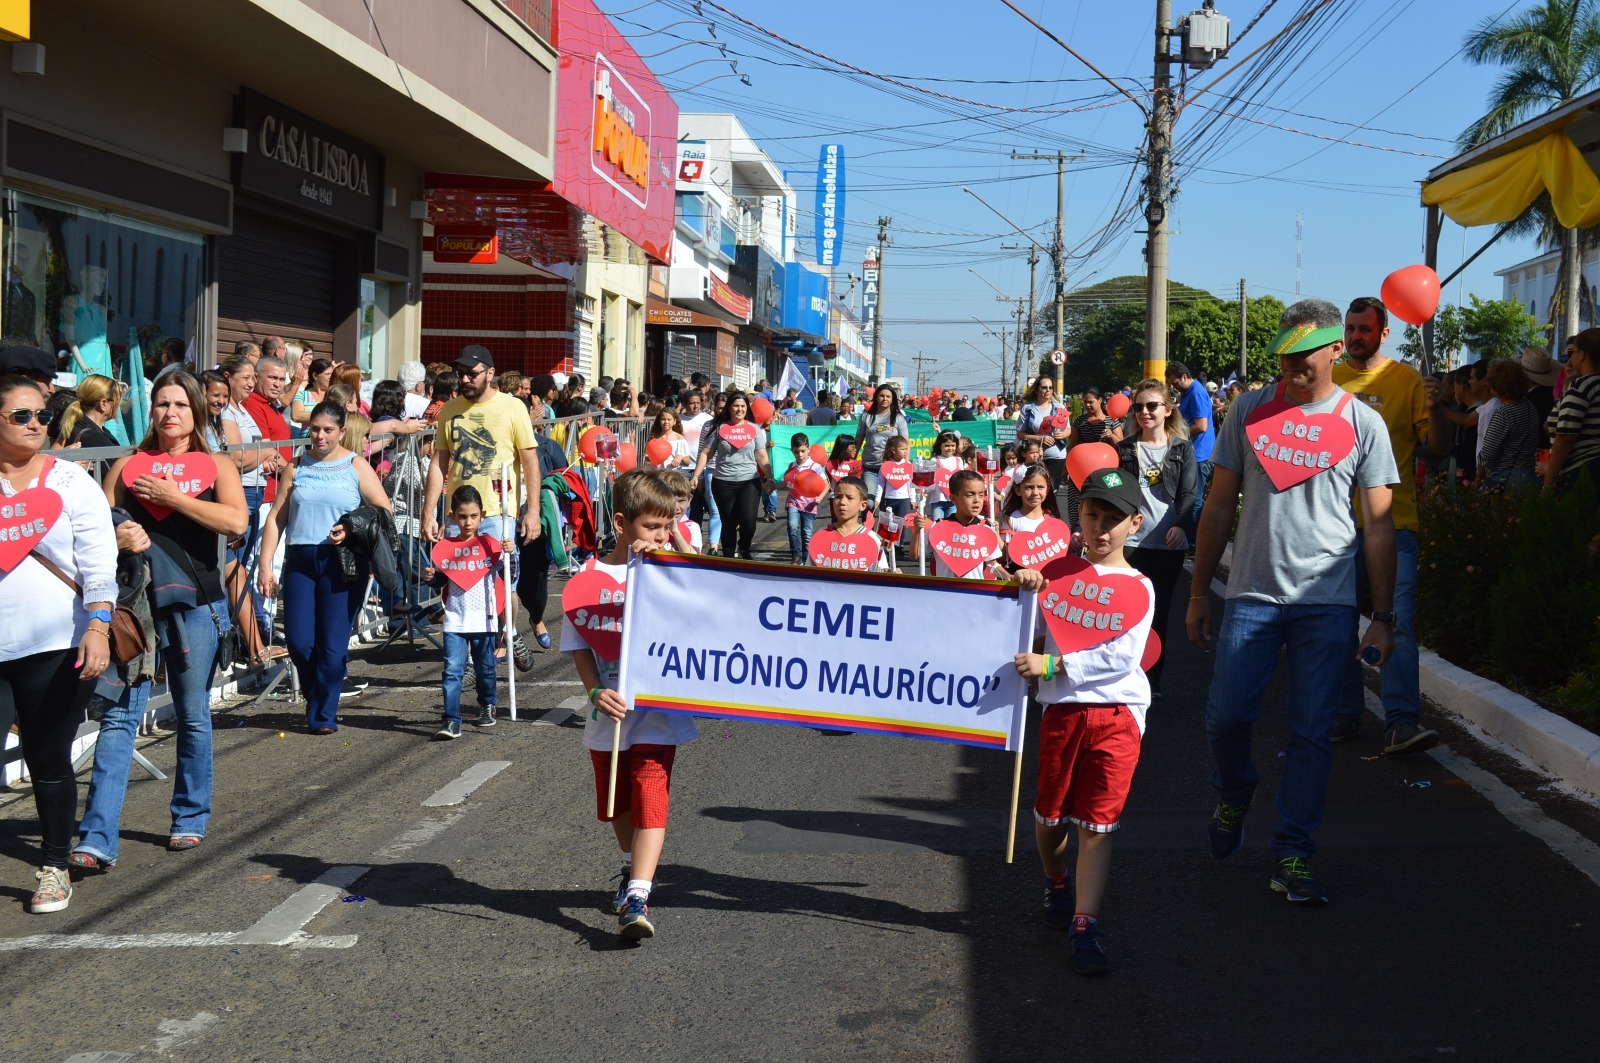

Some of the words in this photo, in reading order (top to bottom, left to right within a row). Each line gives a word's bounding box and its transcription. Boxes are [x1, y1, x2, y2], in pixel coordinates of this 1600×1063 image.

[259, 114, 310, 173] CASA
[311, 136, 370, 197] LISBOA
[682, 150, 706, 160] Raia
[300, 179, 319, 201] desde
[822, 144, 838, 265] magazineluiza
[441, 241, 490, 251] POPULAR
[669, 316, 692, 324] CACAU
[1281, 420, 1322, 442] DOE
[1253, 434, 1331, 469] SANGUE
[0, 502, 27, 520] OE
[0, 517, 48, 543] NGUE
[952, 532, 977, 546] DOE
[829, 541, 856, 555] DOE
[936, 540, 989, 560] SANGUE
[1026, 532, 1052, 550] DOE
[454, 545, 480, 558] DOE
[814, 553, 867, 569] SANGUE
[1021, 538, 1068, 567] SANGUE
[441, 556, 493, 572] SANGUE
[599, 587, 625, 606] DO
[1070, 579, 1115, 606] DOE
[758, 595, 896, 642] CEMEI
[1042, 592, 1124, 632] SANGUE
